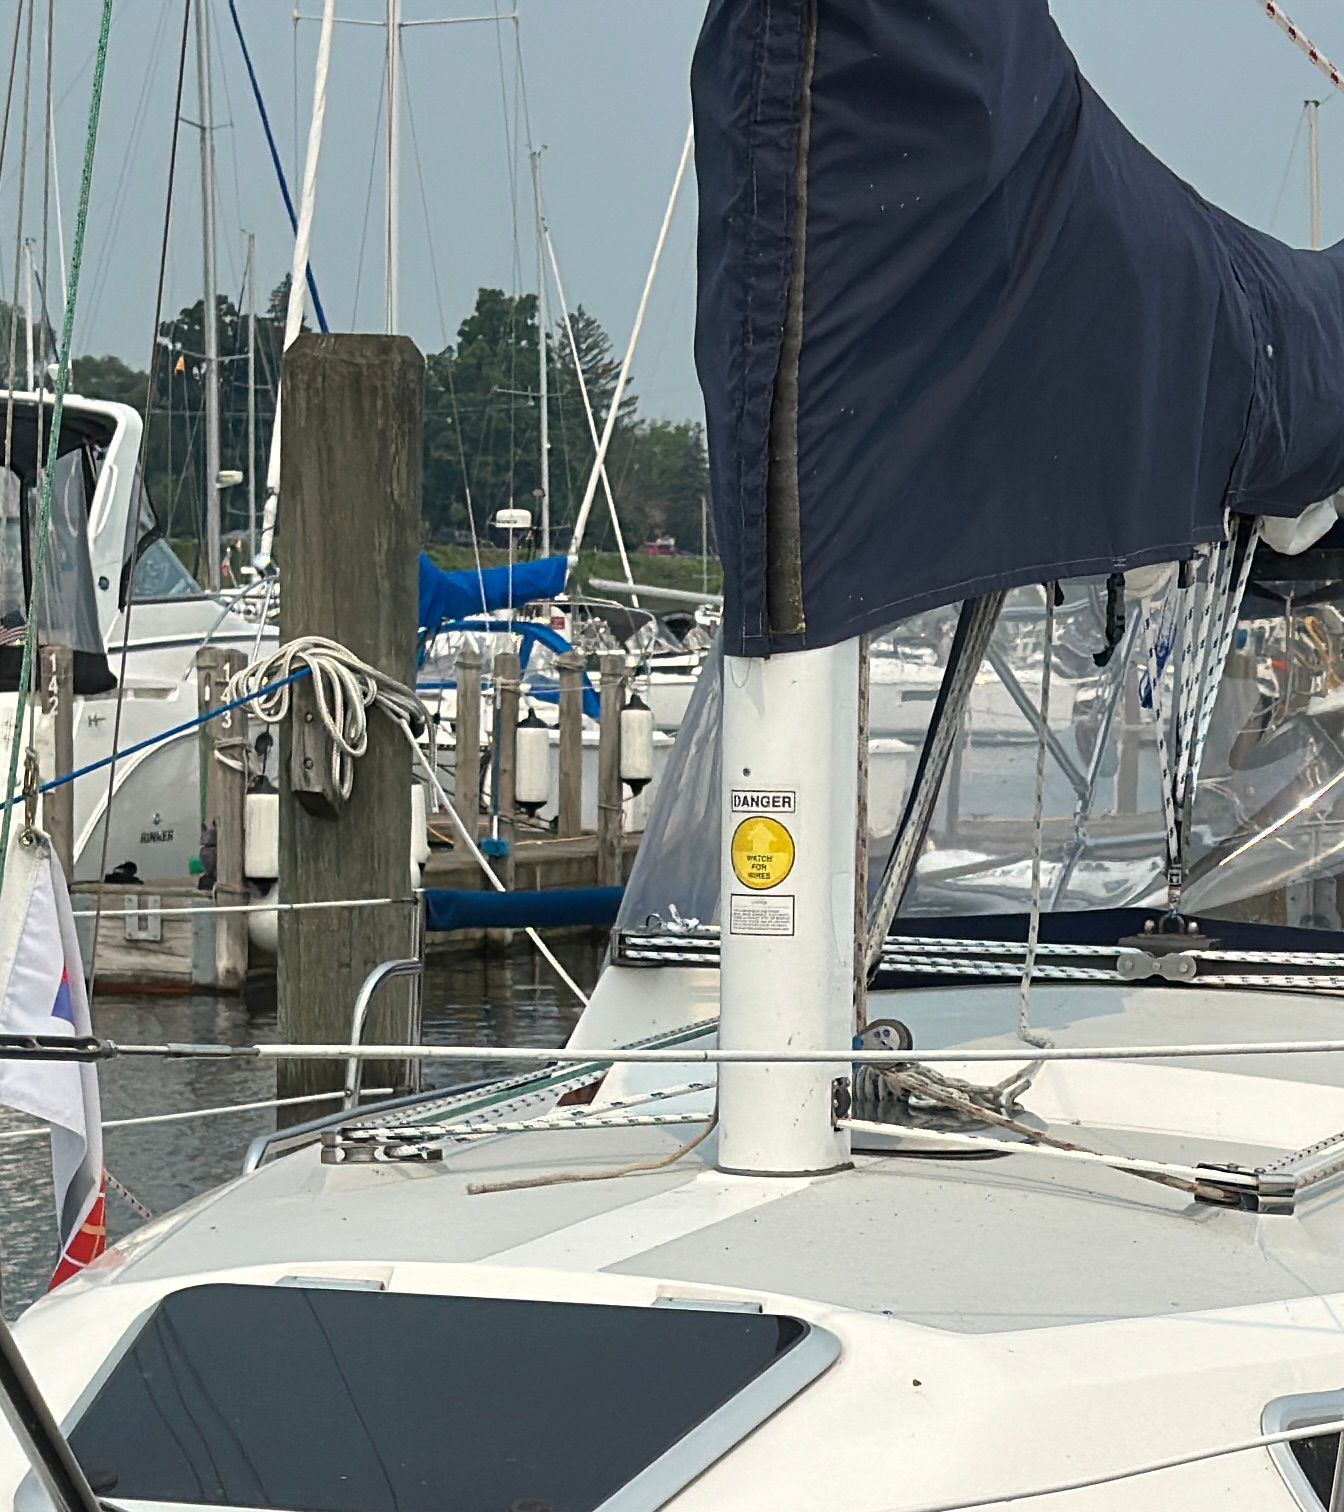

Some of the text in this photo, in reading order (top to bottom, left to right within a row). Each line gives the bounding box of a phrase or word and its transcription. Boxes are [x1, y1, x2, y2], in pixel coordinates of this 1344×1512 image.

[48, 653, 59, 716] 142
[220, 662, 232, 729] 143
[733, 794, 792, 808] DANGER
[751, 863, 767, 871] FOR
